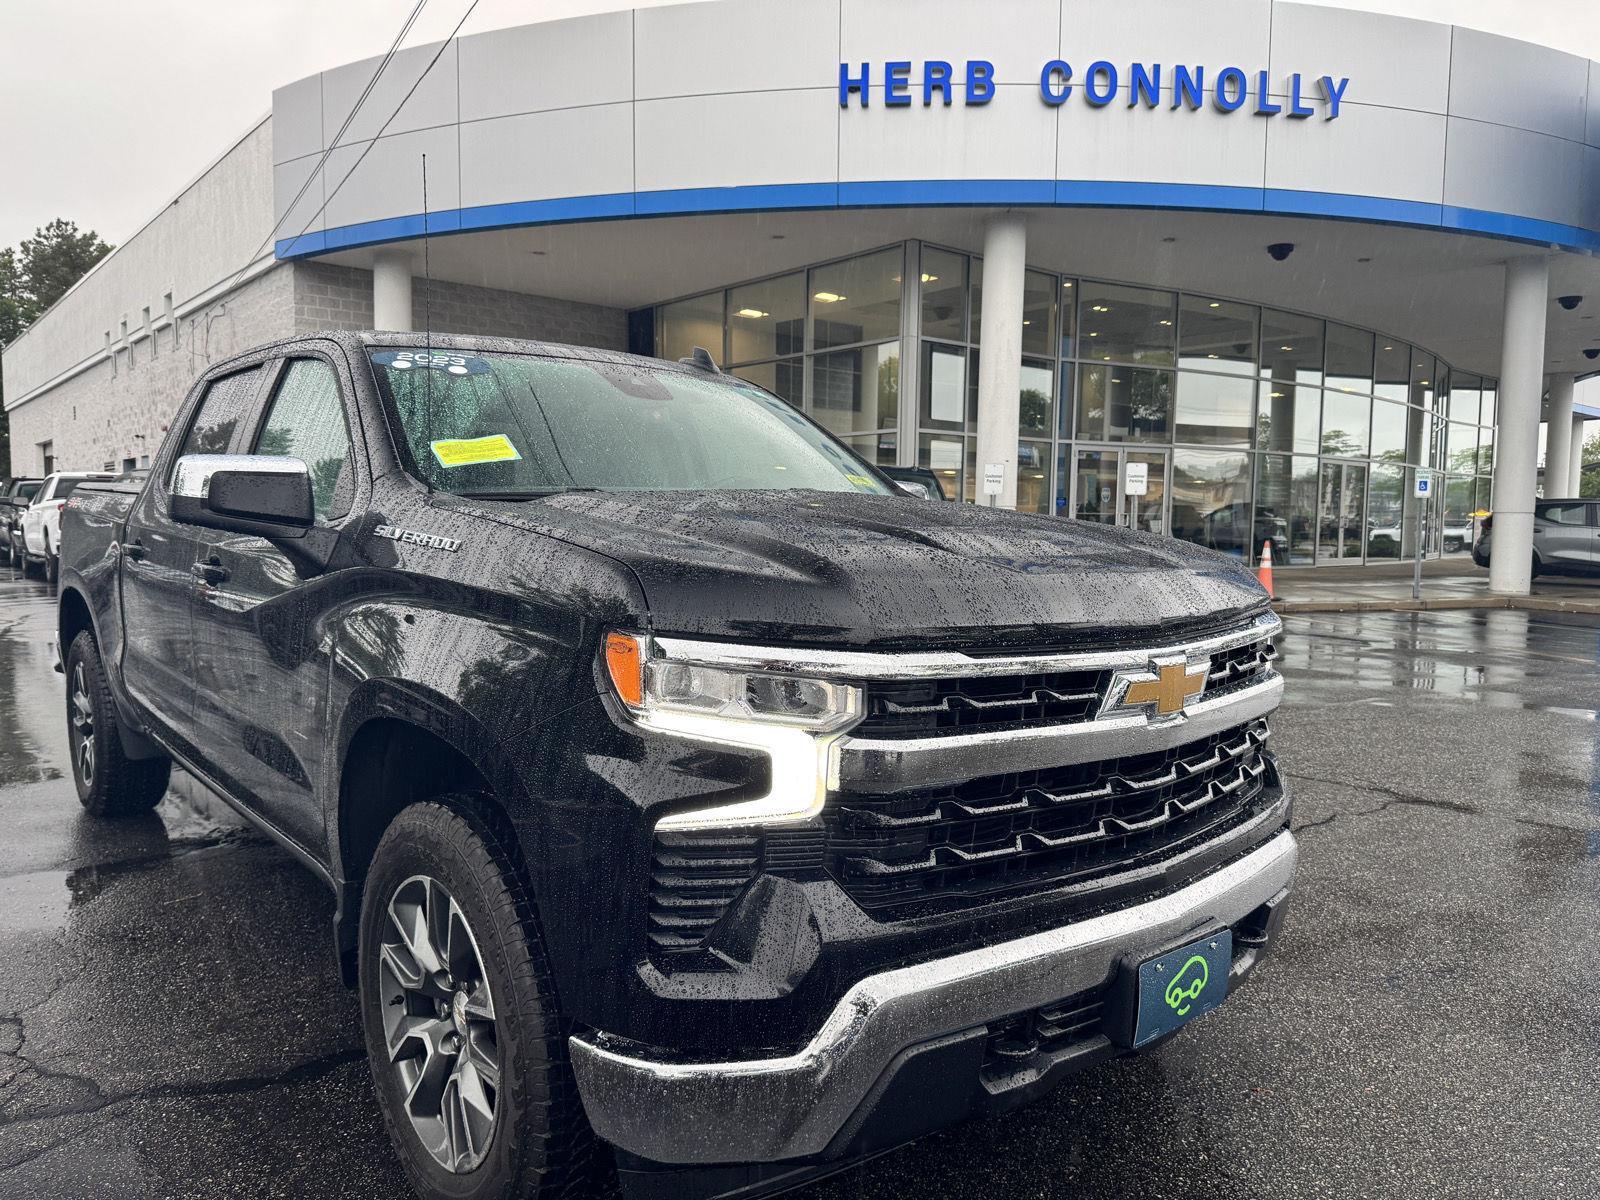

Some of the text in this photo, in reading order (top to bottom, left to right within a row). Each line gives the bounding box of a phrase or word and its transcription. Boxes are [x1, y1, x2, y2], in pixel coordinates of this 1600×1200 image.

[839, 60, 1349, 121] HERB CONNOLLY
[396, 352, 466, 366] 2023
[373, 525, 462, 552] SILVERADO
